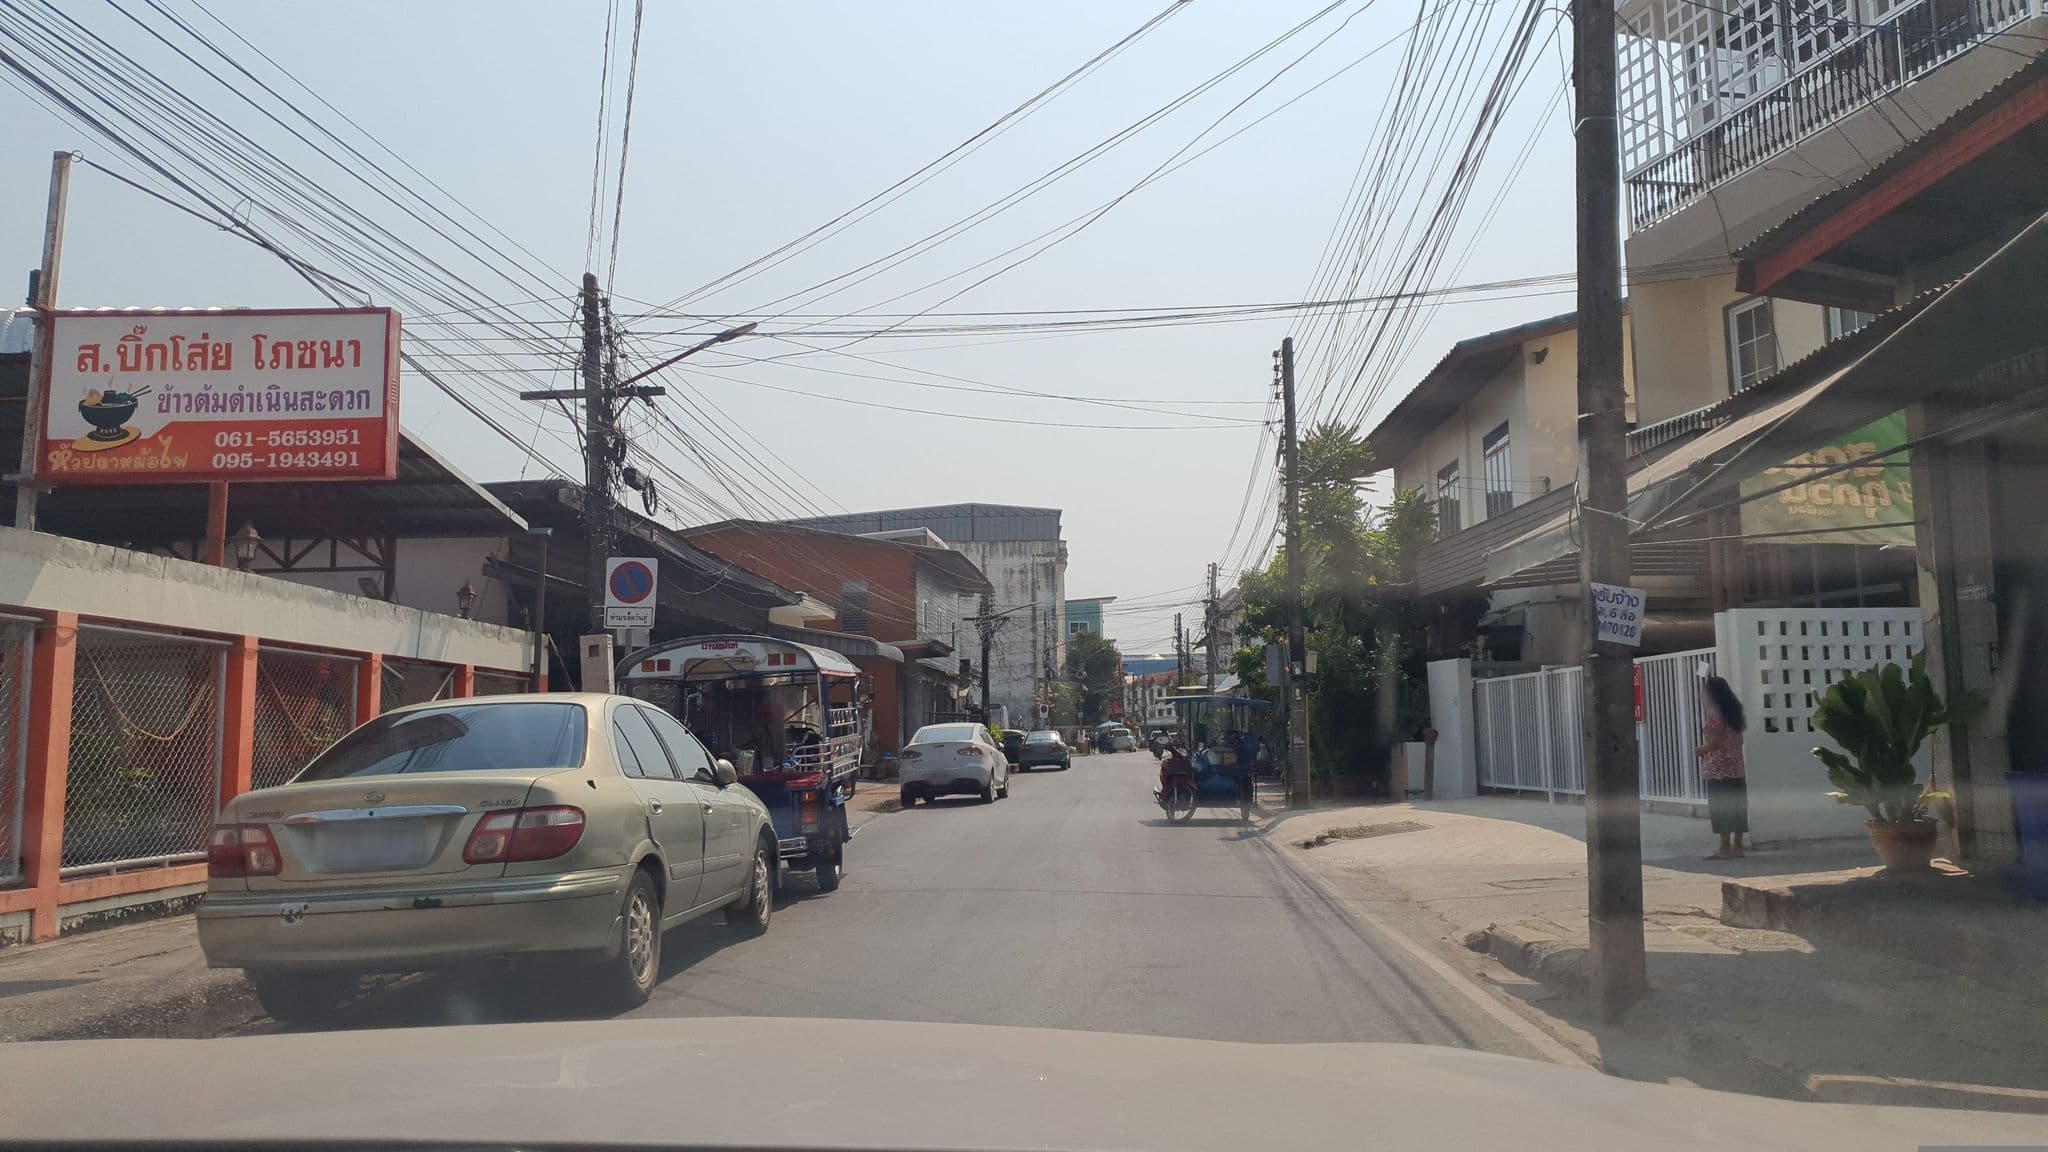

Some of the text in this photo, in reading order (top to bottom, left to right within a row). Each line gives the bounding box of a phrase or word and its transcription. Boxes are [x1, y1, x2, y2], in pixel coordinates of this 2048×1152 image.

[77, 324, 361, 373] ส.บิ๊กโส่ย โภชนา
[158, 384, 371, 414] ข้าวต้มดำเนินสะดวก
[214, 429, 361, 448] 061-5653951
[212, 451, 360, 469] 095-1943491
